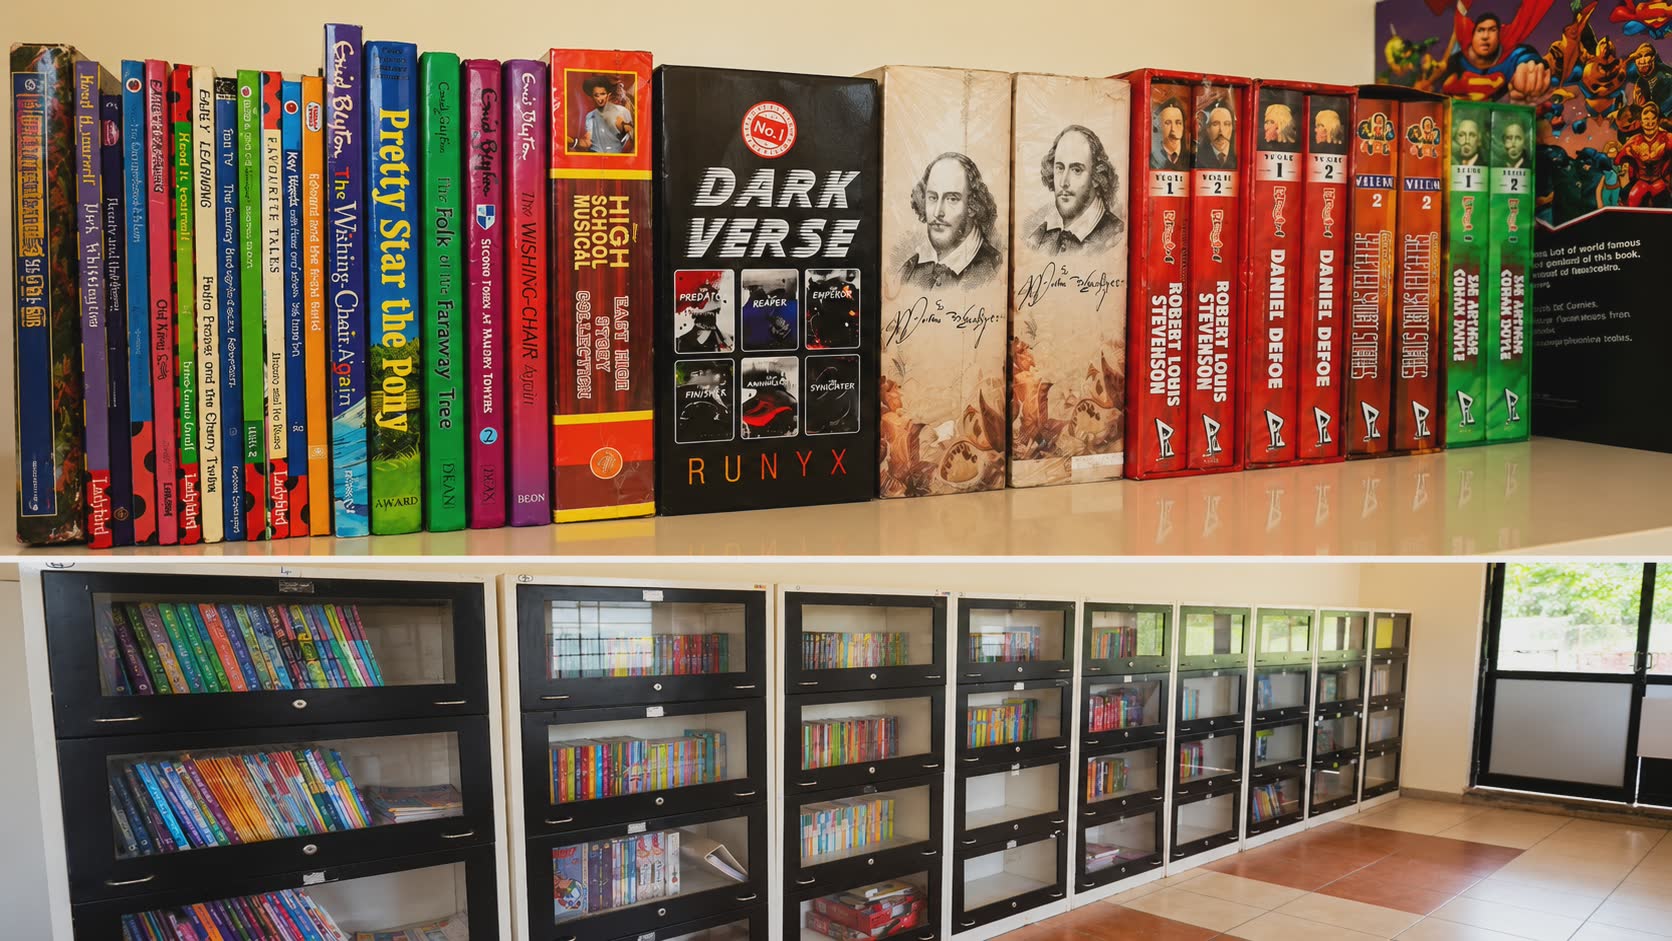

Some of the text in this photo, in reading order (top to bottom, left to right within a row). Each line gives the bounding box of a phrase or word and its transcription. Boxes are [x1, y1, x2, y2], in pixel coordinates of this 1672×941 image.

[371, 107, 411, 212] Pretty
[1276, 162, 1283, 178] 1
[1324, 164, 1333, 179] 2
[334, 167, 351, 200] The
[693, 167, 861, 209] DARK
[1166, 183, 1174, 195] 1
[1213, 182, 1222, 194] 2
[1372, 193, 1382, 208] 2
[1422, 195, 1432, 210] 2
[1510, 178, 1518, 191] 2
[434, 207, 455, 247] Folk
[573, 194, 591, 271] MUSICAL
[591, 194, 608, 270] SCHOOL
[608, 195, 630, 268] HIGH
[685, 217, 861, 258] VERSE
[1579, 242, 1605, 253] world
[1607, 239, 1641, 249] famous
[380, 218, 411, 289] Star
[1615, 250, 1641, 260] book.
[381, 297, 414, 348] the
[434, 300, 455, 379] Faraway
[1267, 249, 1285, 389] DANIEL DEFOE
[1316, 250, 1334, 387] DANIEL DEFOE
[1149, 294, 1167, 395] STEVENSON
[1167, 282, 1183, 407] ROBERT LOUIS
[1196, 292, 1214, 391] STEVENSON
[1213, 280, 1230, 403] ROBERT LOUIS
[375, 356, 412, 433] Pony
[438, 387, 456, 429] Tree
[375, 495, 419, 508] AWARD
